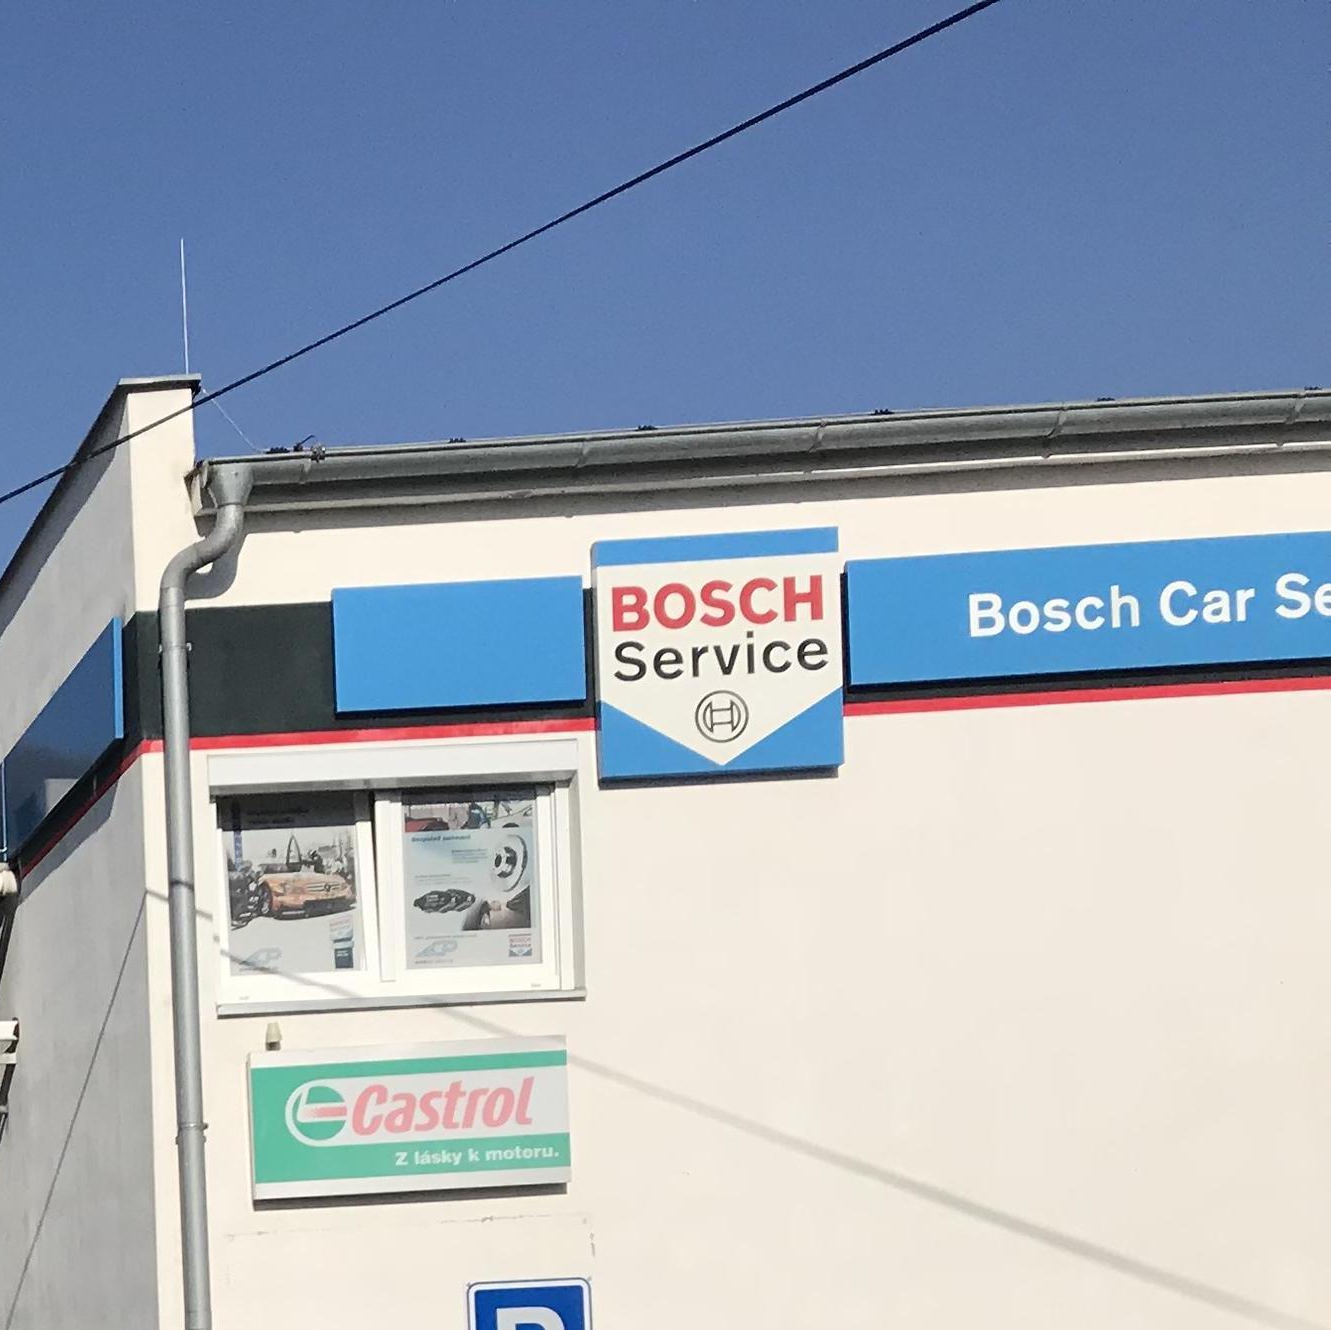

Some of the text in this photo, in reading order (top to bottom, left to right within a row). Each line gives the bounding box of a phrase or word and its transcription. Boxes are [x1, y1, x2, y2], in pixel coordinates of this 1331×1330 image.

[611, 574, 824, 632] BOSCH
[968, 584, 1140, 637] Bosch
[1159, 580, 1255, 626] Car
[613, 630, 829, 682] Service
[351, 1076, 535, 1136] Castrol
[395, 1145, 559, 1166] Z lásky k motoru.
